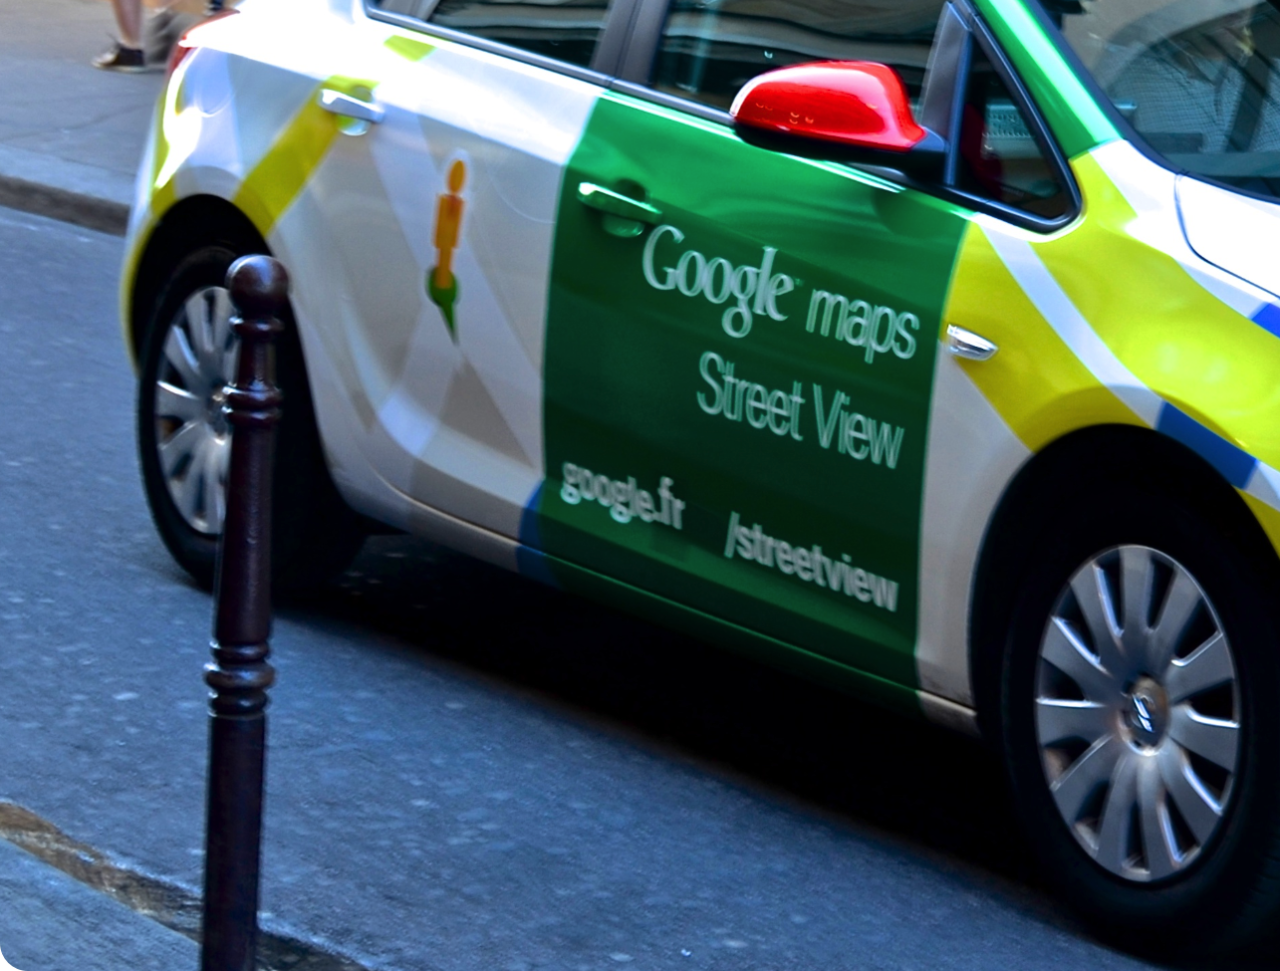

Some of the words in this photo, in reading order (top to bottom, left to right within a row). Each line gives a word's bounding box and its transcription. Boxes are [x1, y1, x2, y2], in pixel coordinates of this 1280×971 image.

[642, 224, 795, 338] Google
[806, 288, 920, 364] maps
[697, 350, 805, 441] Street
[813, 383, 904, 469] View
[560, 461, 685, 529] google.fr
[724, 511, 899, 612] /streetview
